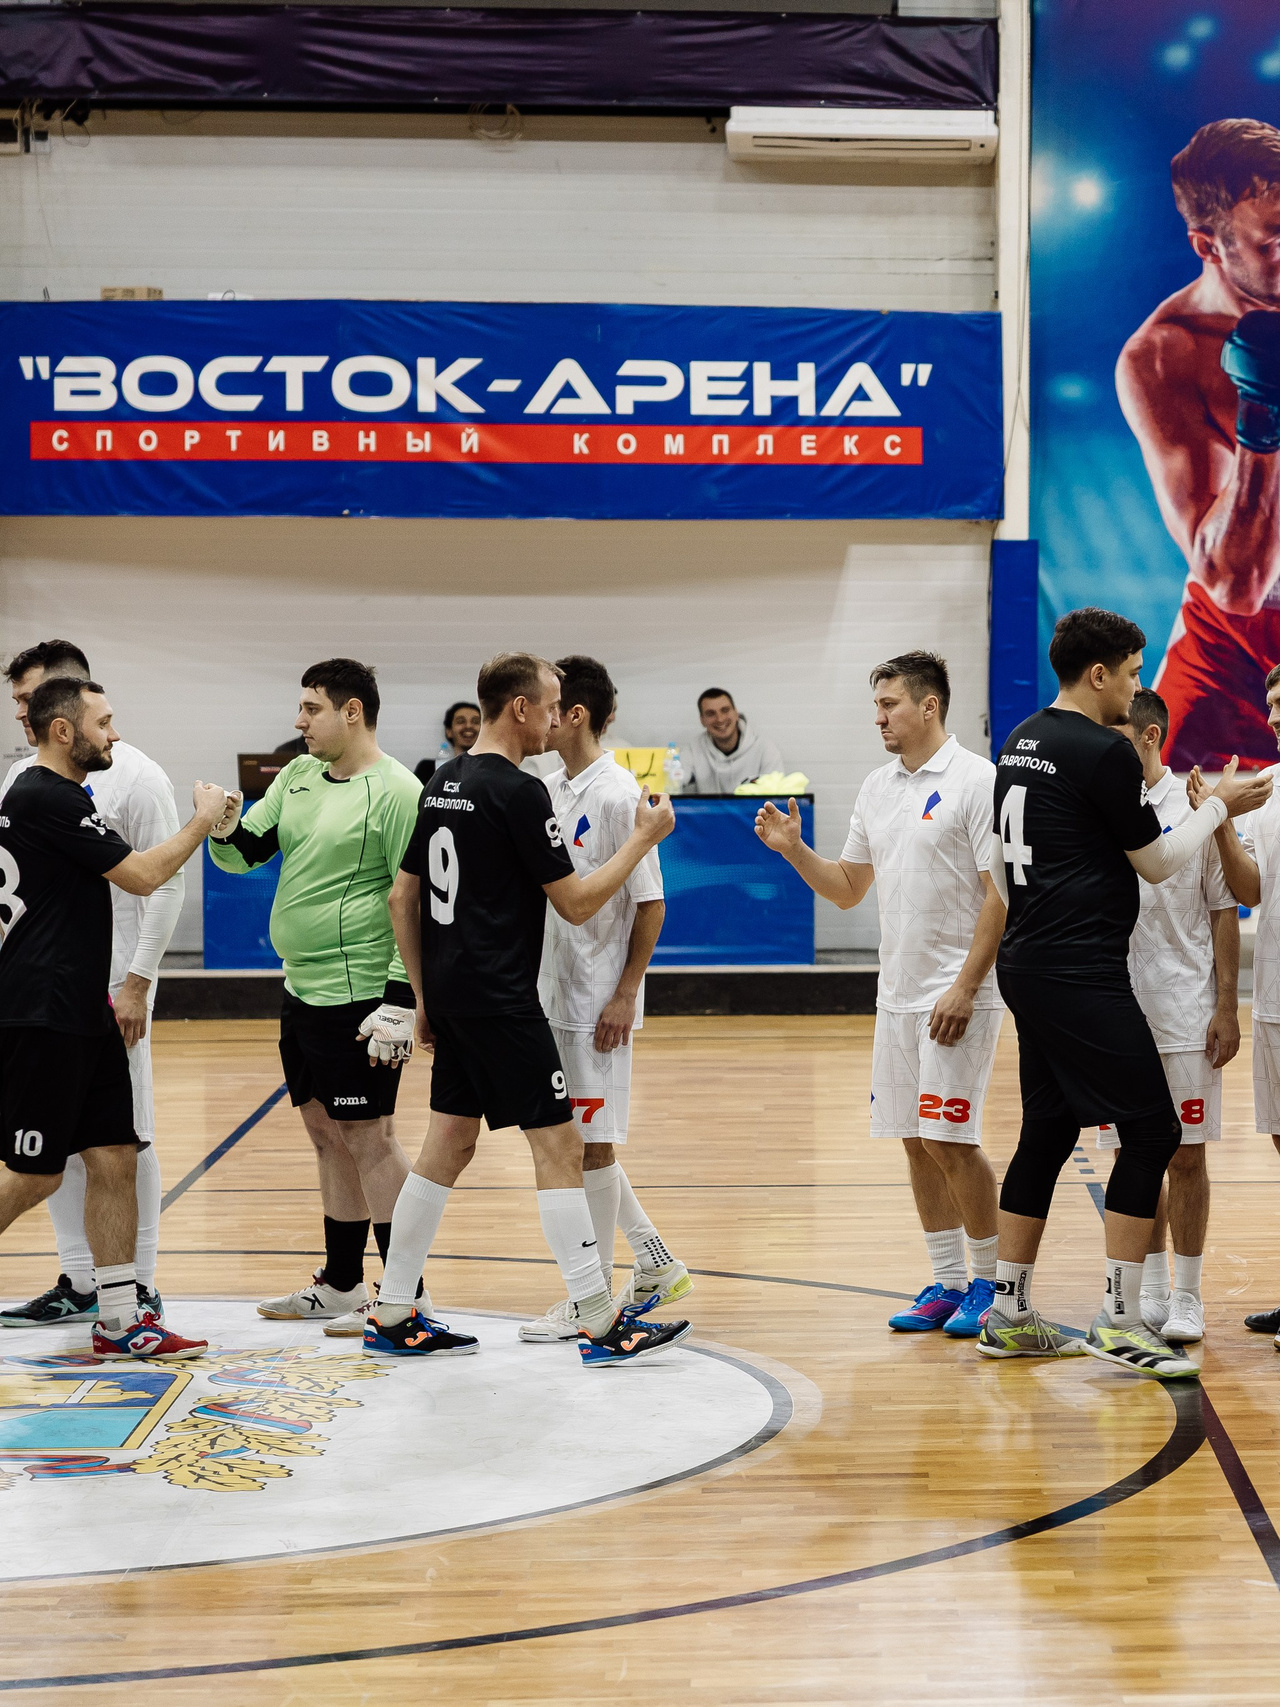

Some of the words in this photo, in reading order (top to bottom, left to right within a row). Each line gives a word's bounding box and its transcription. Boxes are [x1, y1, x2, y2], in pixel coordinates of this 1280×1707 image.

[51, 427, 480, 454] СПОРТИВНЫЙ
[572, 432, 903, 456] КОМПЛЕКС
[1000, 784, 1033, 886] 4
[428, 826, 460, 925] 9
[551, 1070, 568, 1100] 9
[919, 1093, 971, 1124] 23
[1180, 1098, 1205, 1125] 8
[14, 1129, 43, 1157] 10
